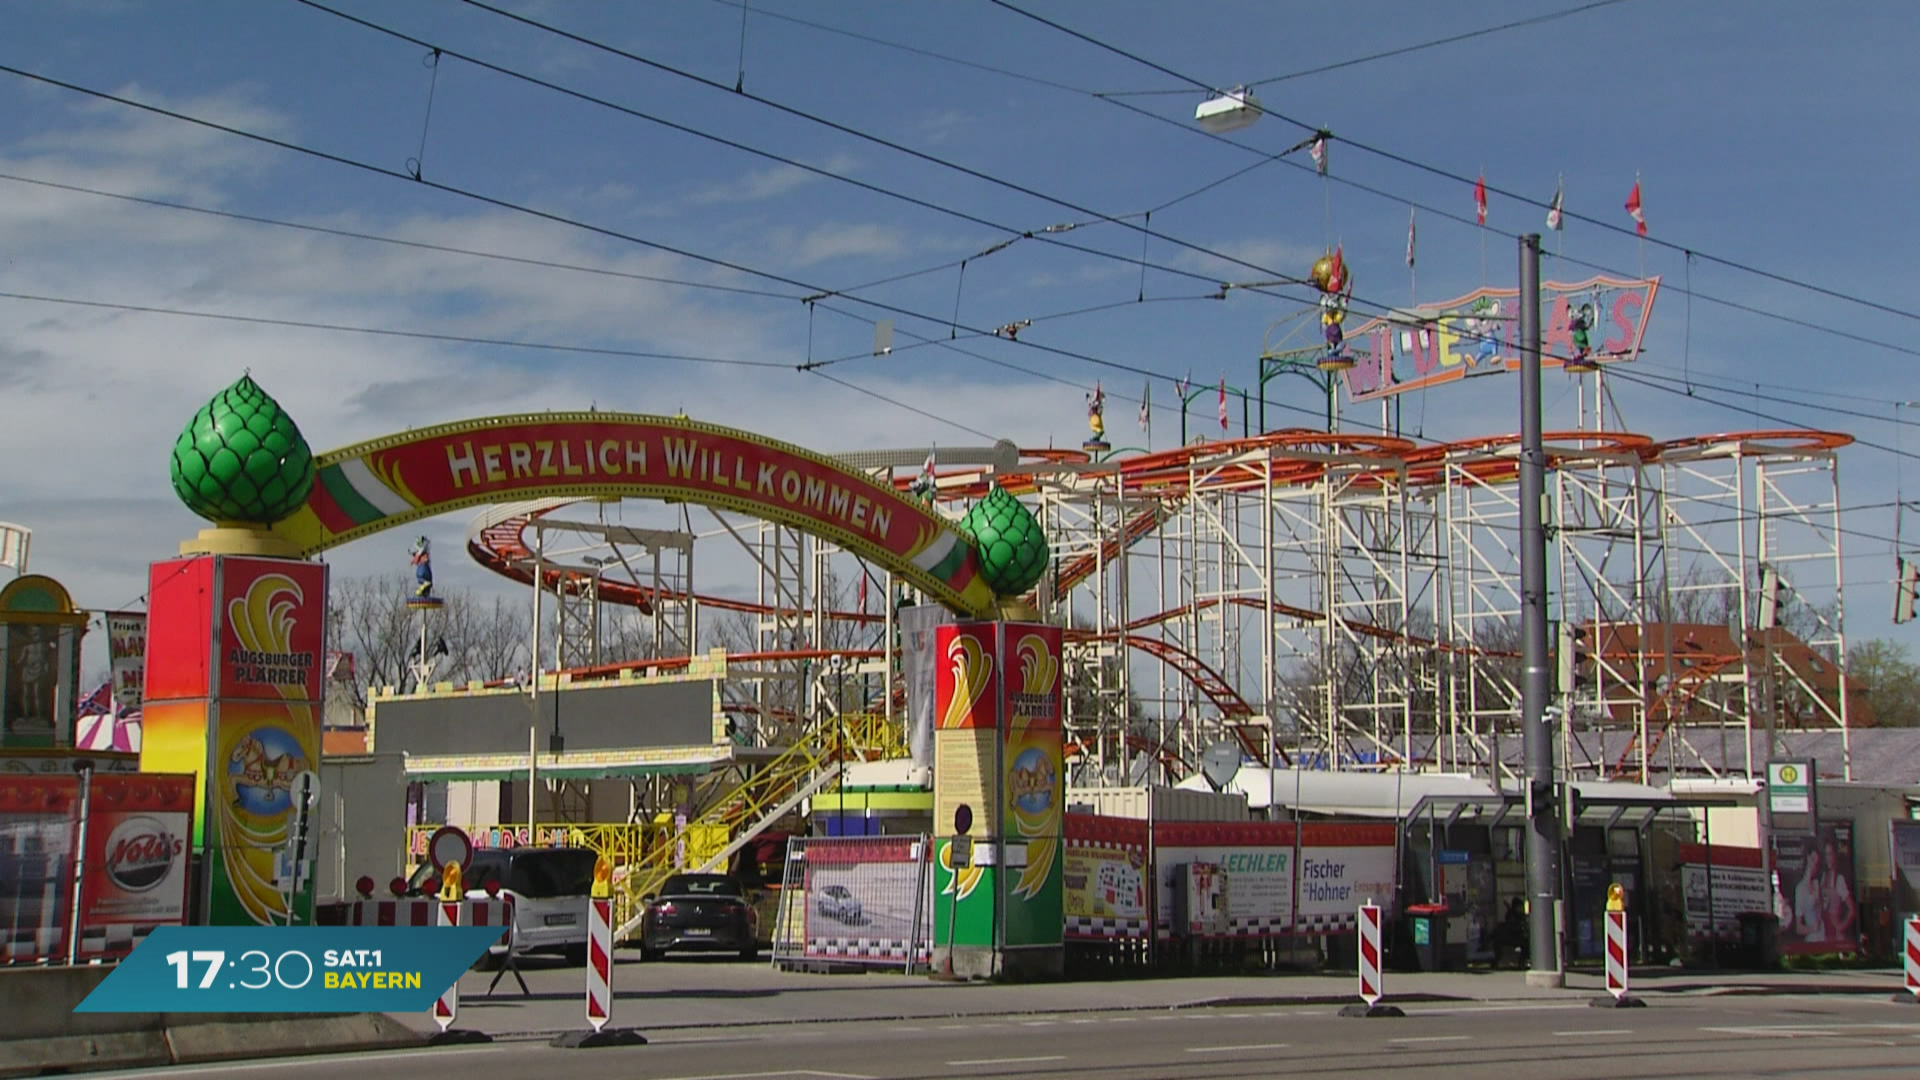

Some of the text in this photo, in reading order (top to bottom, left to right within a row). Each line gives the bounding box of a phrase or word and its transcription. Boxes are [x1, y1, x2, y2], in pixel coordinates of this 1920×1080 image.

[445, 435, 892, 540] HERZLICH WILLKOMMEN
[230, 649, 313, 667] AUGSBURGER
[235, 665, 307, 684] PLÄRRER
[1303, 858, 1346, 879] Fischer
[1309, 881, 1351, 901] Hohner
